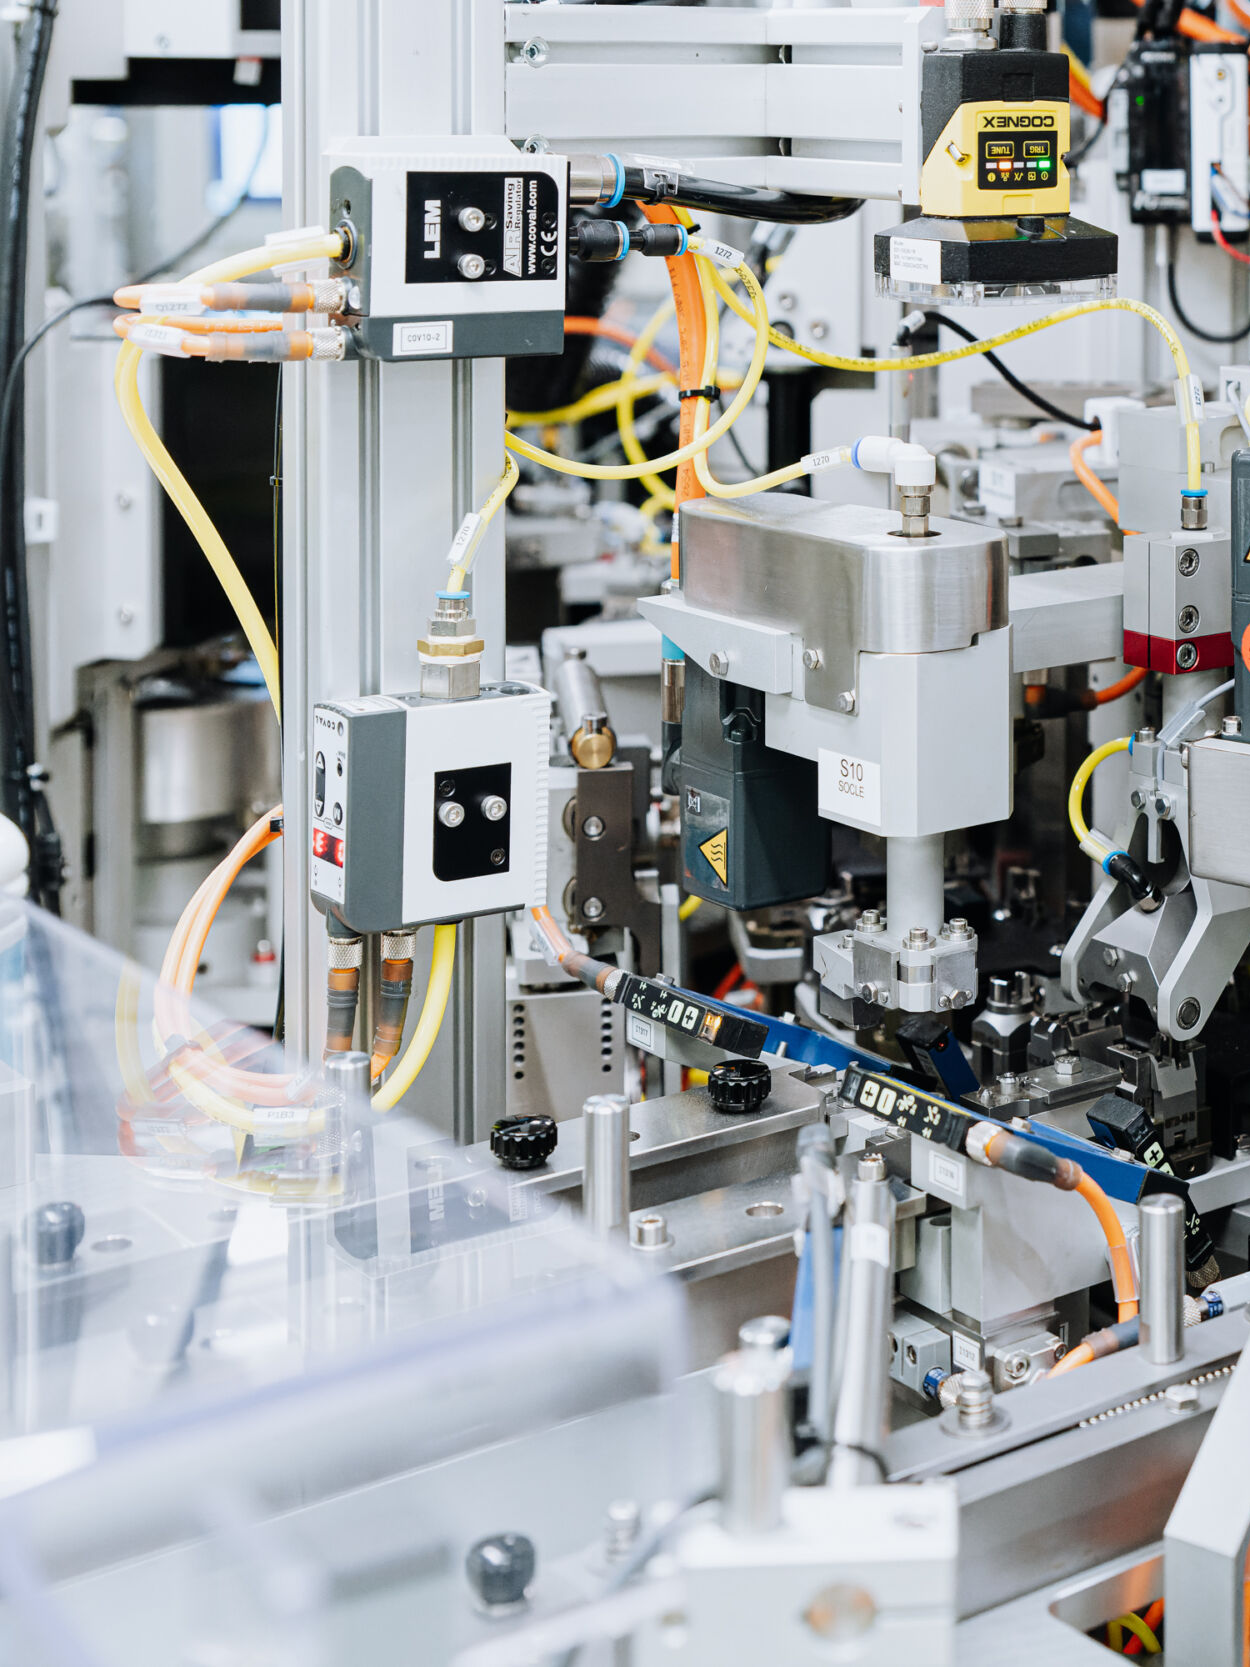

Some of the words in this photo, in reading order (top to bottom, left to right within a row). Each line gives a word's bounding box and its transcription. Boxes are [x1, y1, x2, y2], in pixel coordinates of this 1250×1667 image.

[983, 115, 1055, 128] COGNEX
[991, 145, 1010, 155] TUNE
[1029, 145, 1045, 154] TRIG
[505, 183, 515, 229] Saving
[514, 179, 523, 230] Regulator
[424, 199, 441, 259] LEM
[527, 180, 538, 275] www.coval.com
[714, 246, 732, 260] 1272
[812, 455, 830, 467] 1270
[456, 525, 471, 547] 1270
[315, 715, 336, 730] COVAL
[840, 758, 863, 781] S10
[838, 780, 864, 798] SOCLE
